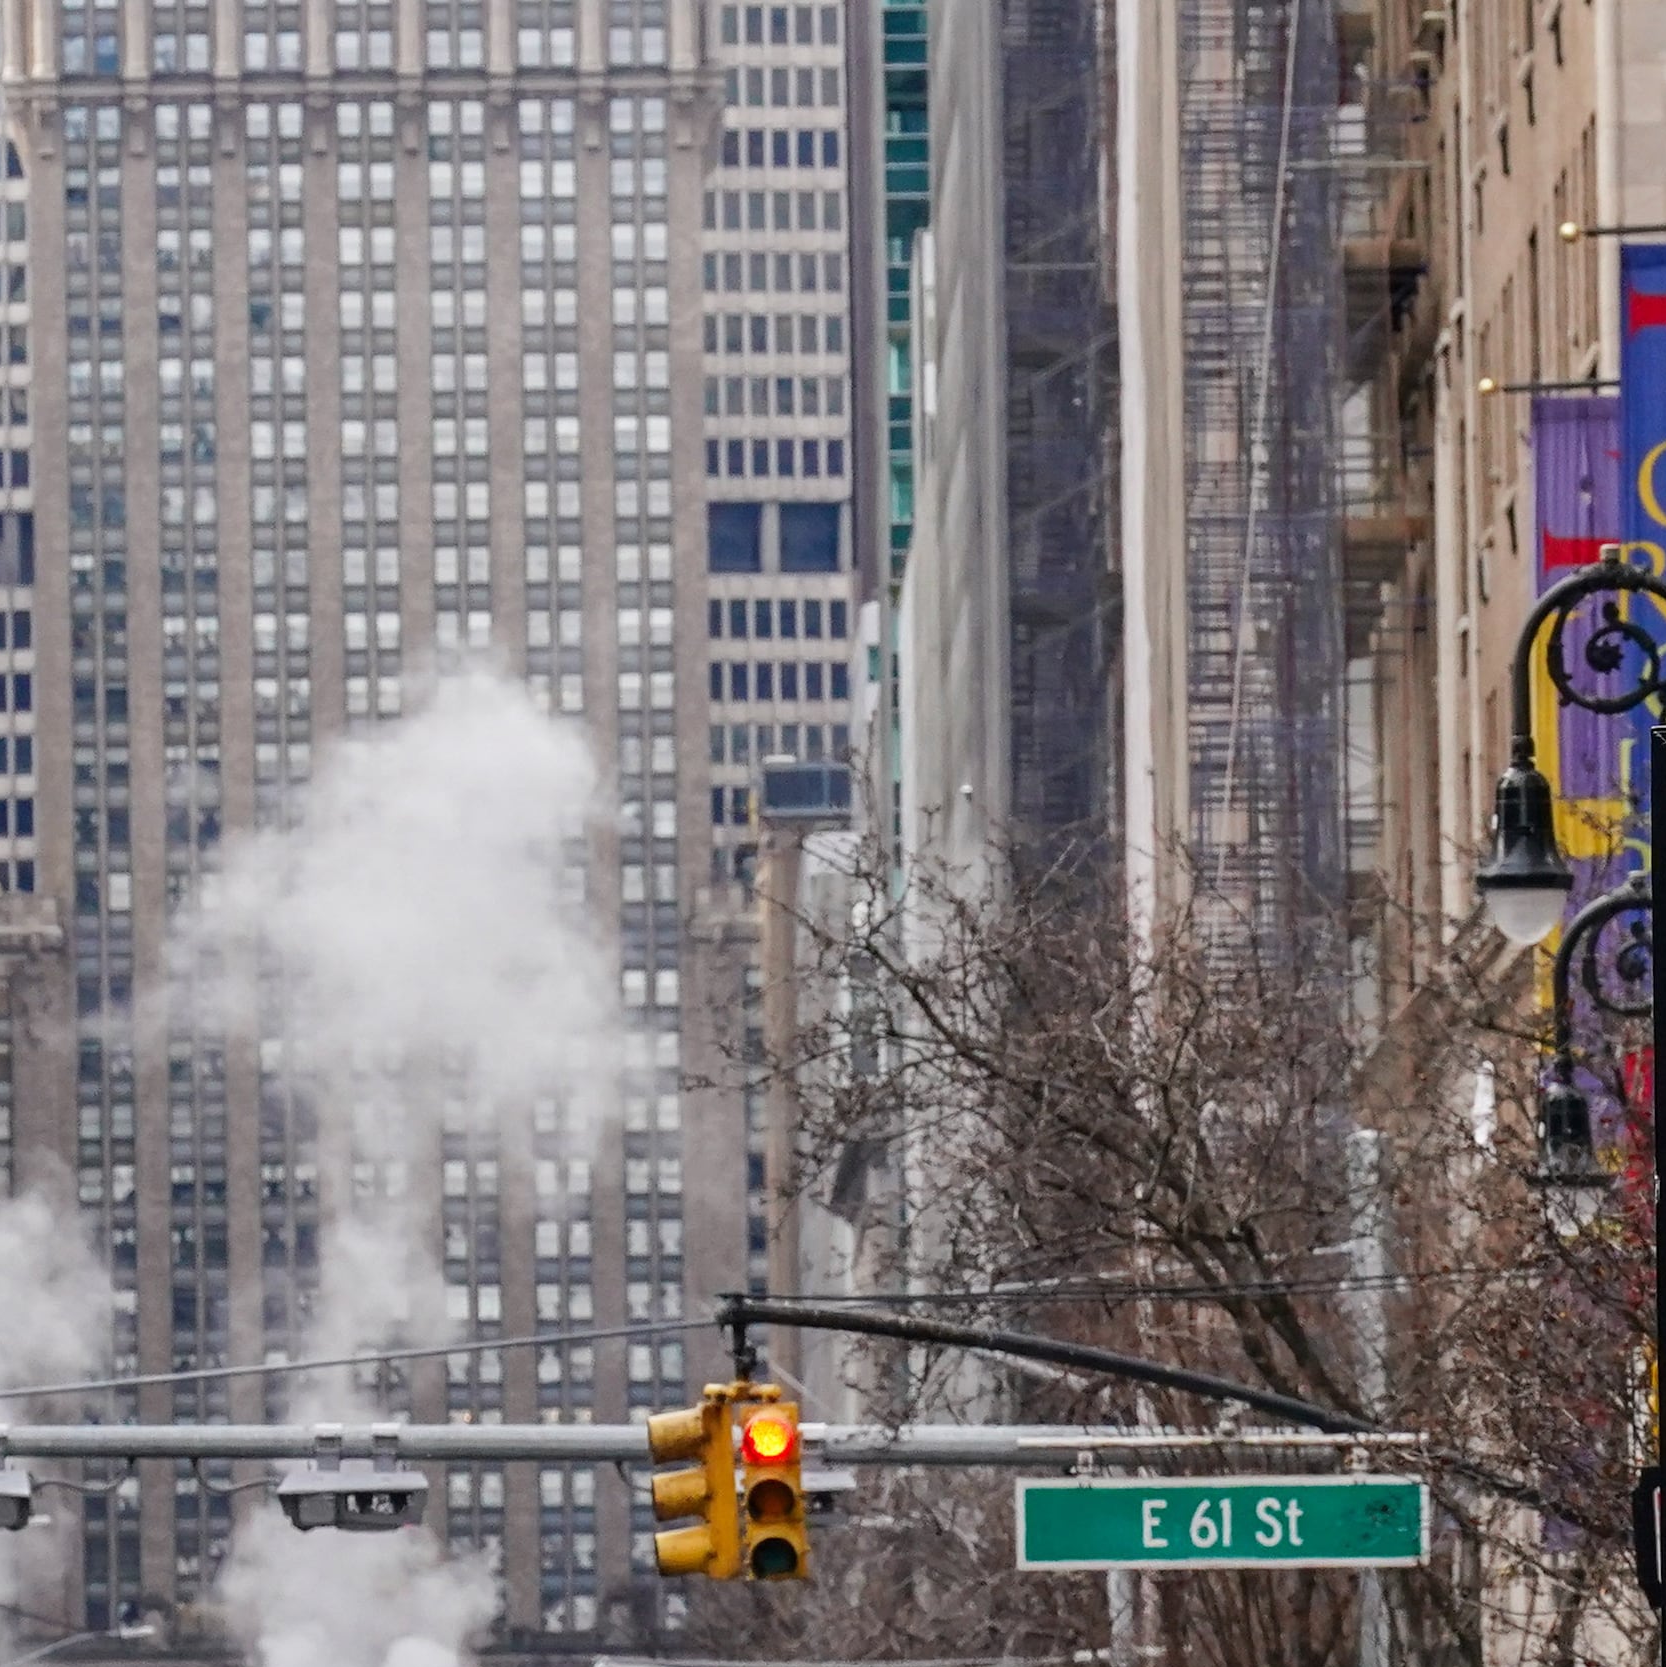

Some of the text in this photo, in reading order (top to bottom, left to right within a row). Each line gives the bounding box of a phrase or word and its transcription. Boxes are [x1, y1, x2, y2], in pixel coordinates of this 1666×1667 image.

[1142, 1497, 1304, 1548] E 61 St
